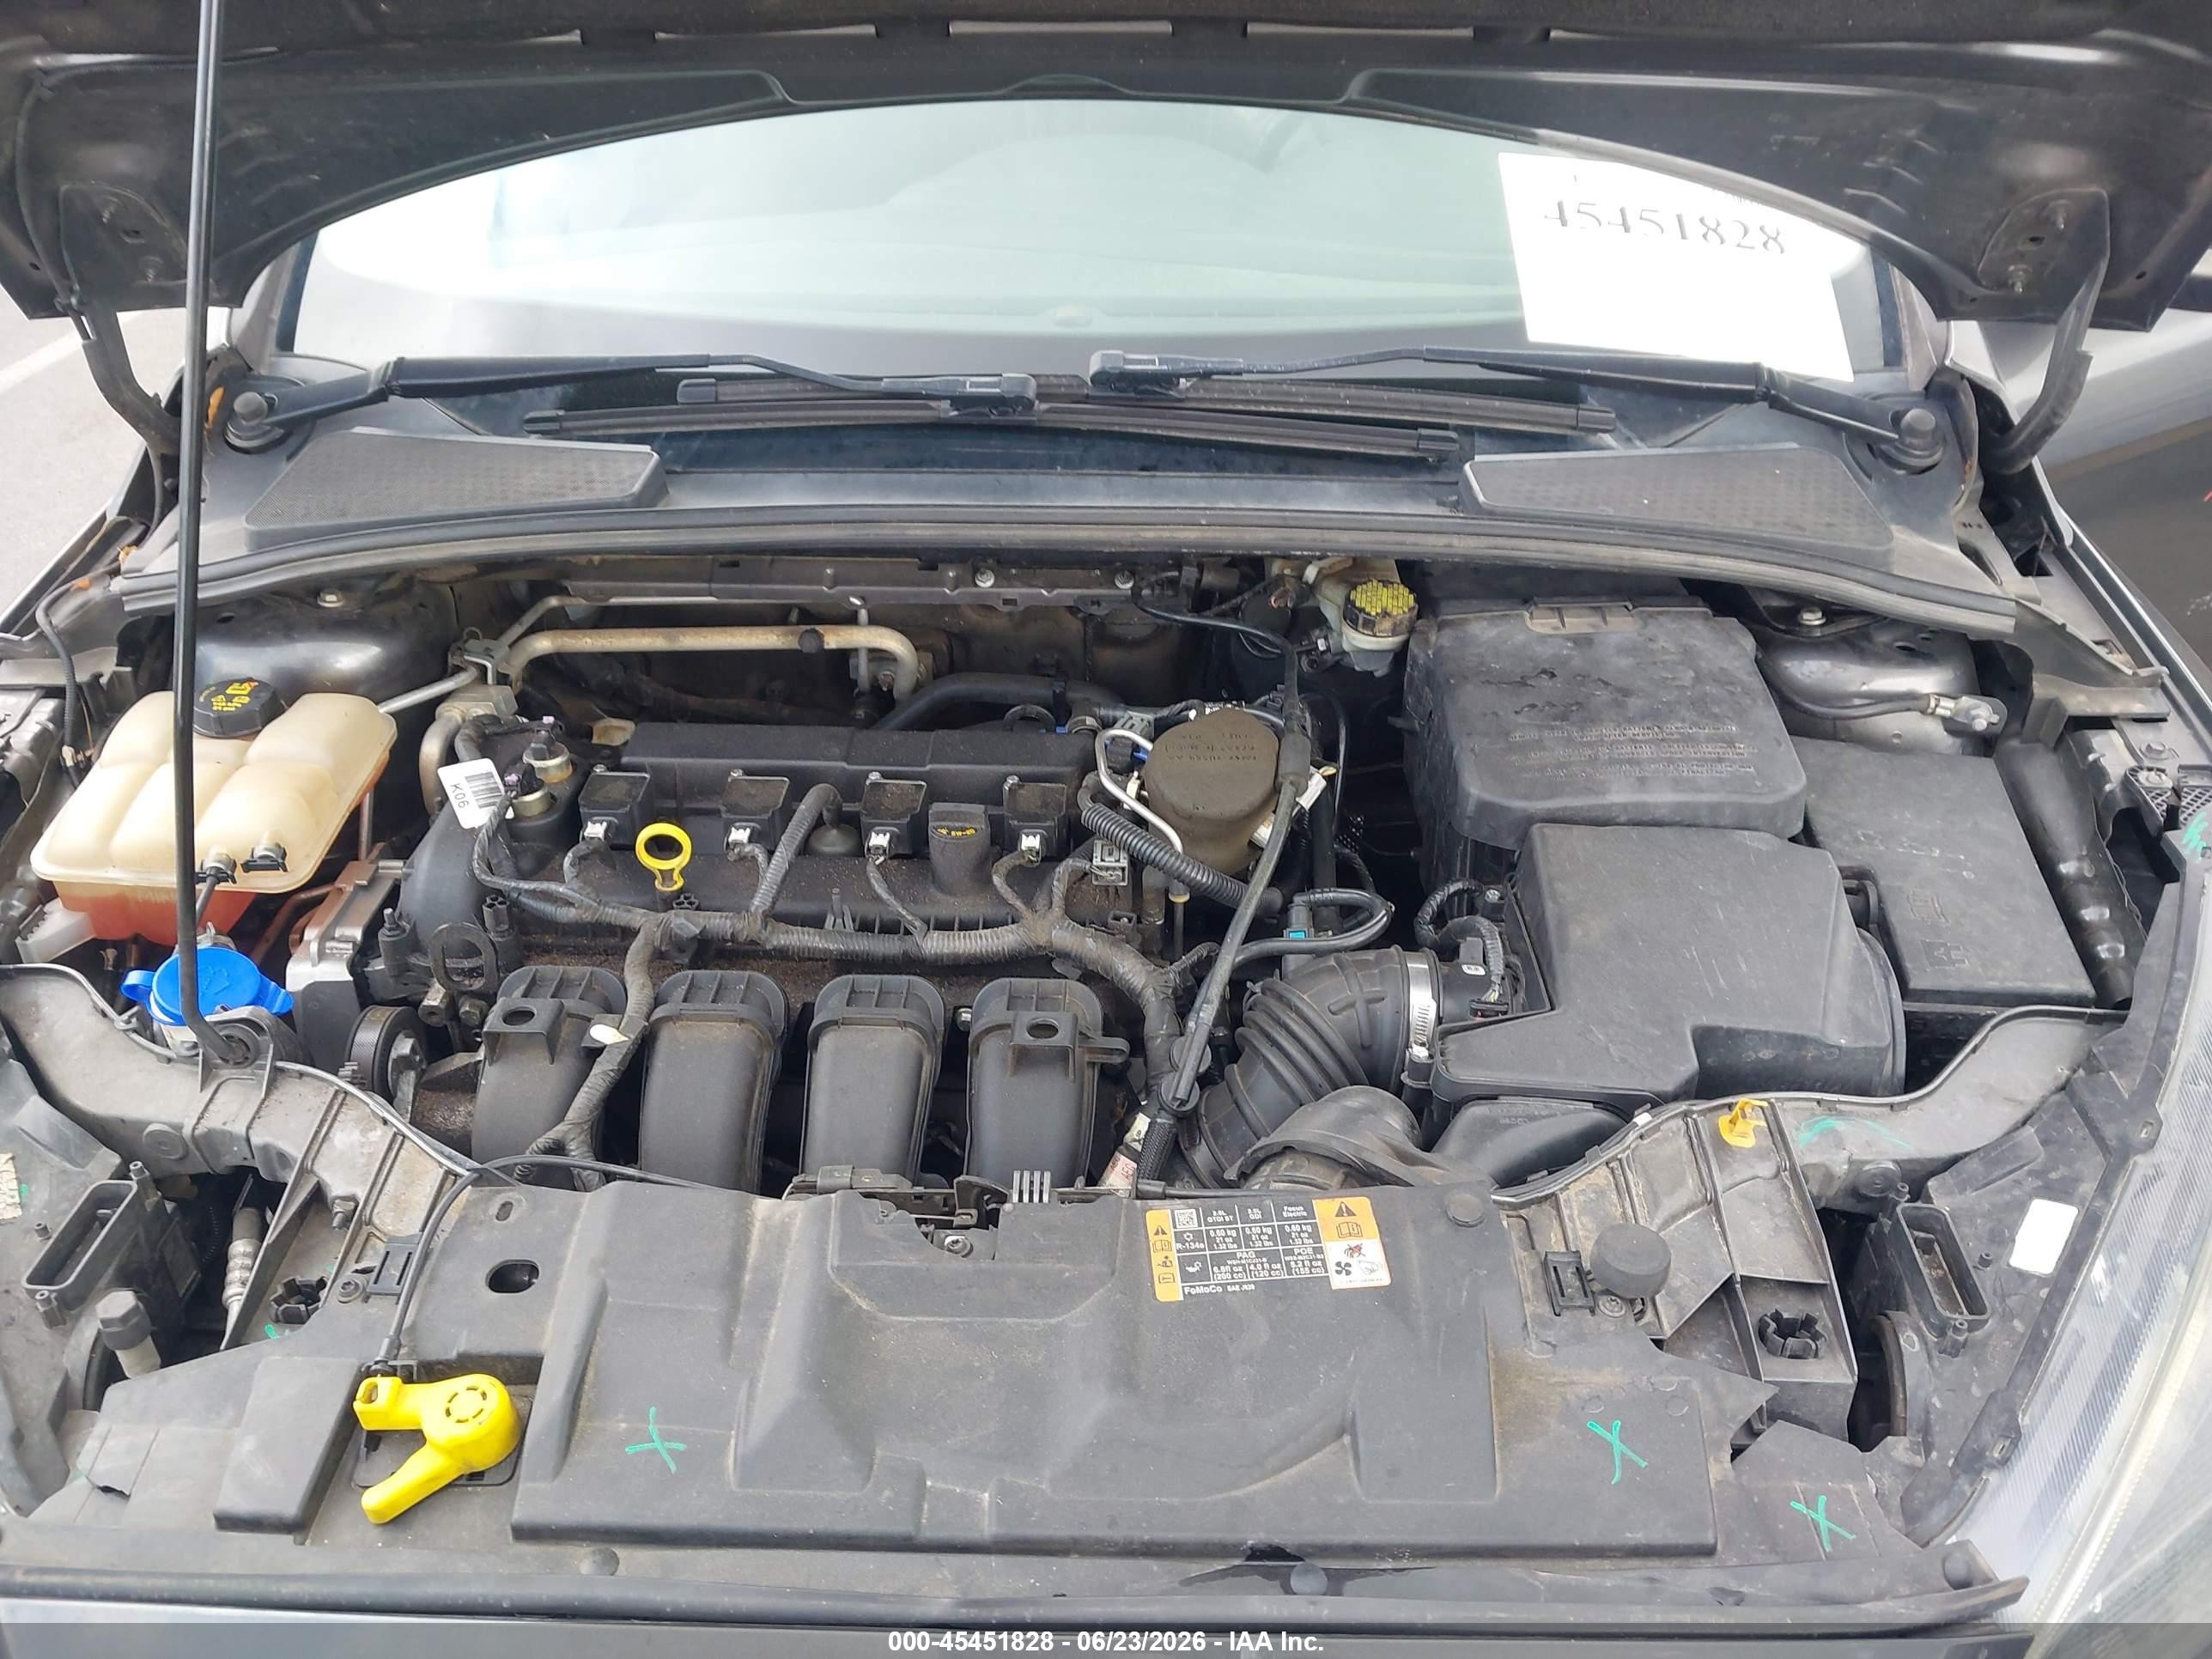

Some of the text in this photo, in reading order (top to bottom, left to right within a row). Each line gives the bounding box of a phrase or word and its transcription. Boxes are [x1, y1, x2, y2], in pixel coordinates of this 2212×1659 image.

[1544, 199, 1785, 254] 45451828
[450, 783, 470, 809] K06
[1209, 1228, 1237, 1237] 0.60 kg
[1261, 1225, 1272, 1235] kg
[1302, 1224, 1312, 1232] kg
[1176, 1242, 1205, 1250] R-134a
[1237, 1251, 1256, 1260] PAG
[1213, 1273, 1231, 1281] (200
[1251, 1269, 1284, 1279] (120 cc)
[1184, 1285, 1223, 1295] FoMoCo
